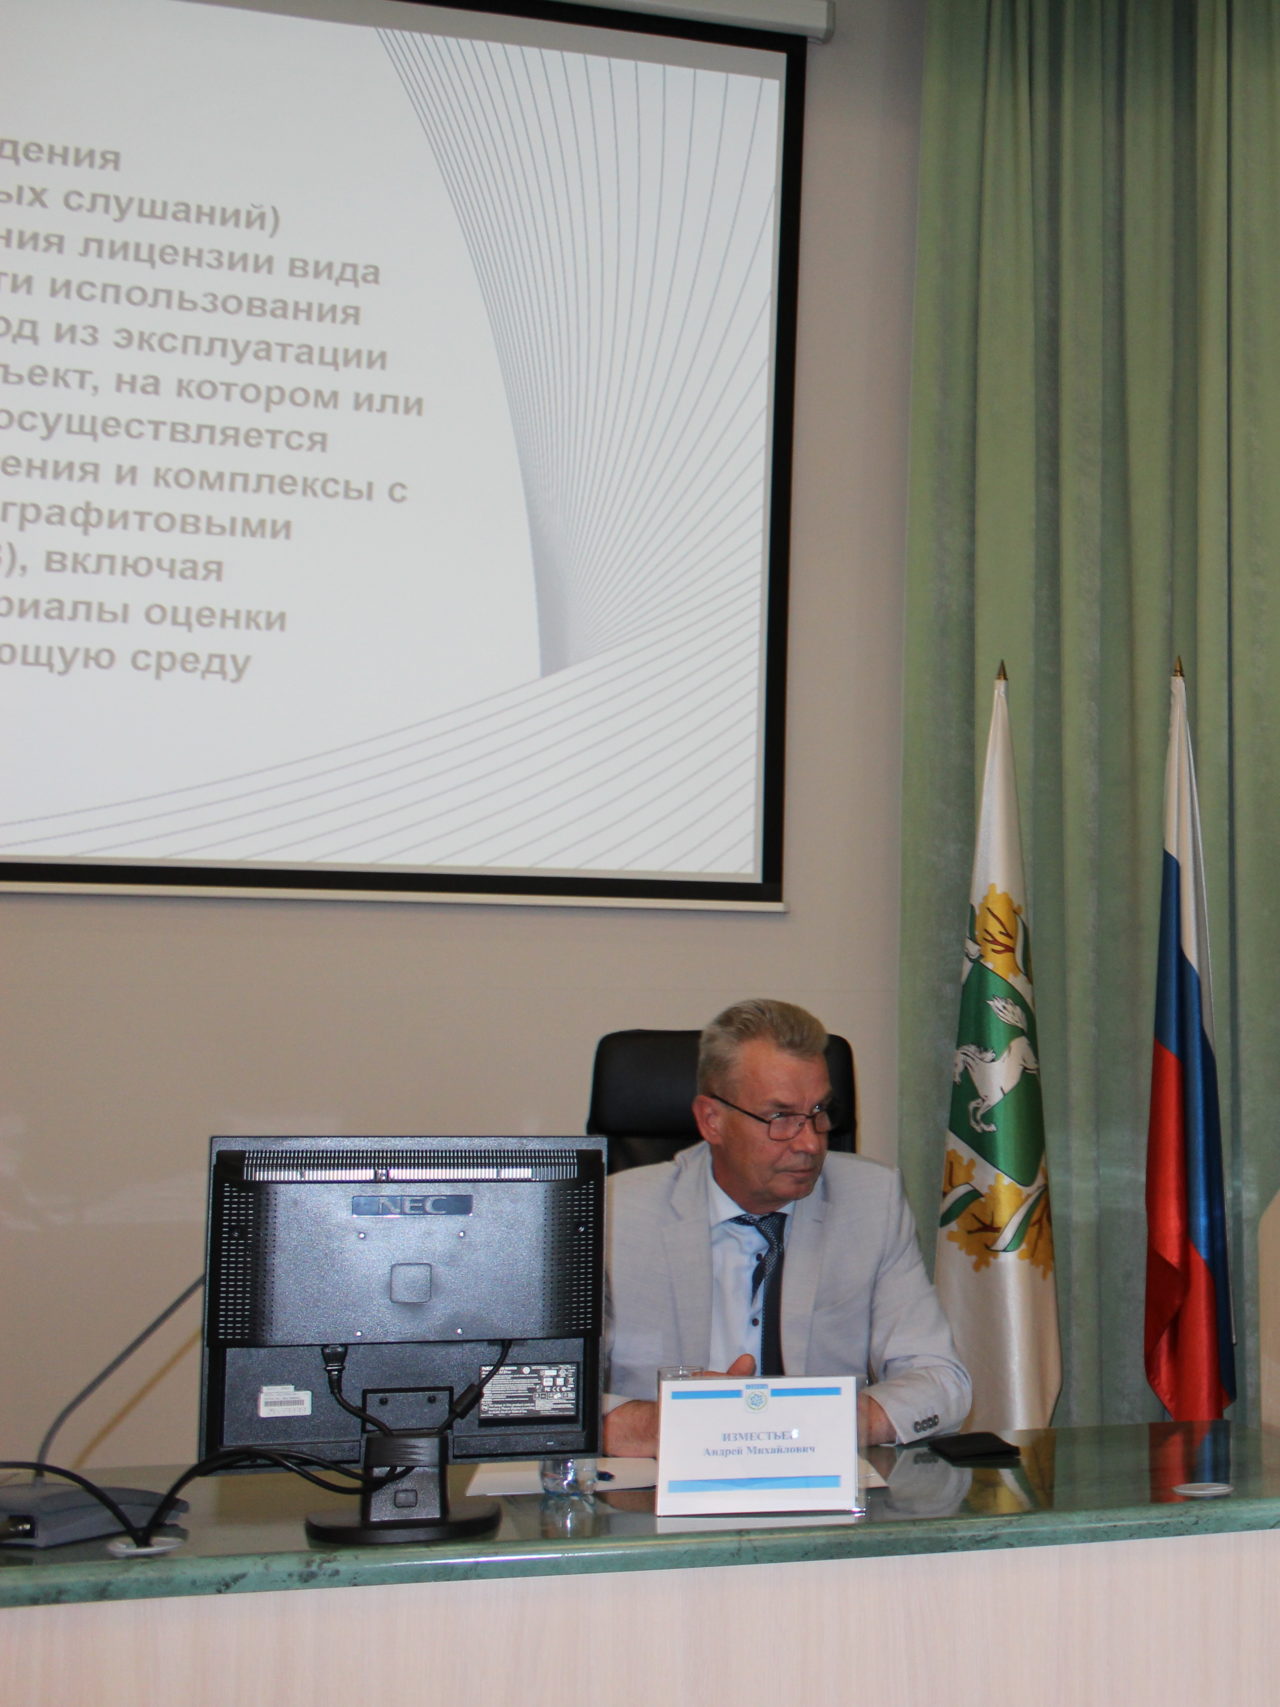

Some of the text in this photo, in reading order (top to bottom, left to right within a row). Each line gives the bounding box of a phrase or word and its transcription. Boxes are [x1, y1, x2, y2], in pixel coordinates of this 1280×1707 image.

[0, 138, 121, 171] дения
[63, 190, 280, 238] слушаний)
[78, 237, 274, 275] лицензии
[288, 257, 380, 288] вида
[49, 277, 361, 326] использования
[54, 322, 99, 346] из
[113, 328, 387, 372] эксплуатации
[115, 373, 161, 396] на
[176, 378, 339, 413] котором
[353, 392, 423, 416] или
[0, 408, 328, 453] осуществляется
[0, 455, 408, 504] ения и комплексы с
[0, 500, 292, 540] графитовыми
[44, 550, 224, 582] включая
[144, 603, 286, 633] оценки
[131, 649, 252, 684] среду
[377, 1196, 448, 1214] NEC
[703, 1445, 816, 1458] Андрей Михайлович
[722, 1430, 799, 1442] ИЗМЕСТЬЕ
